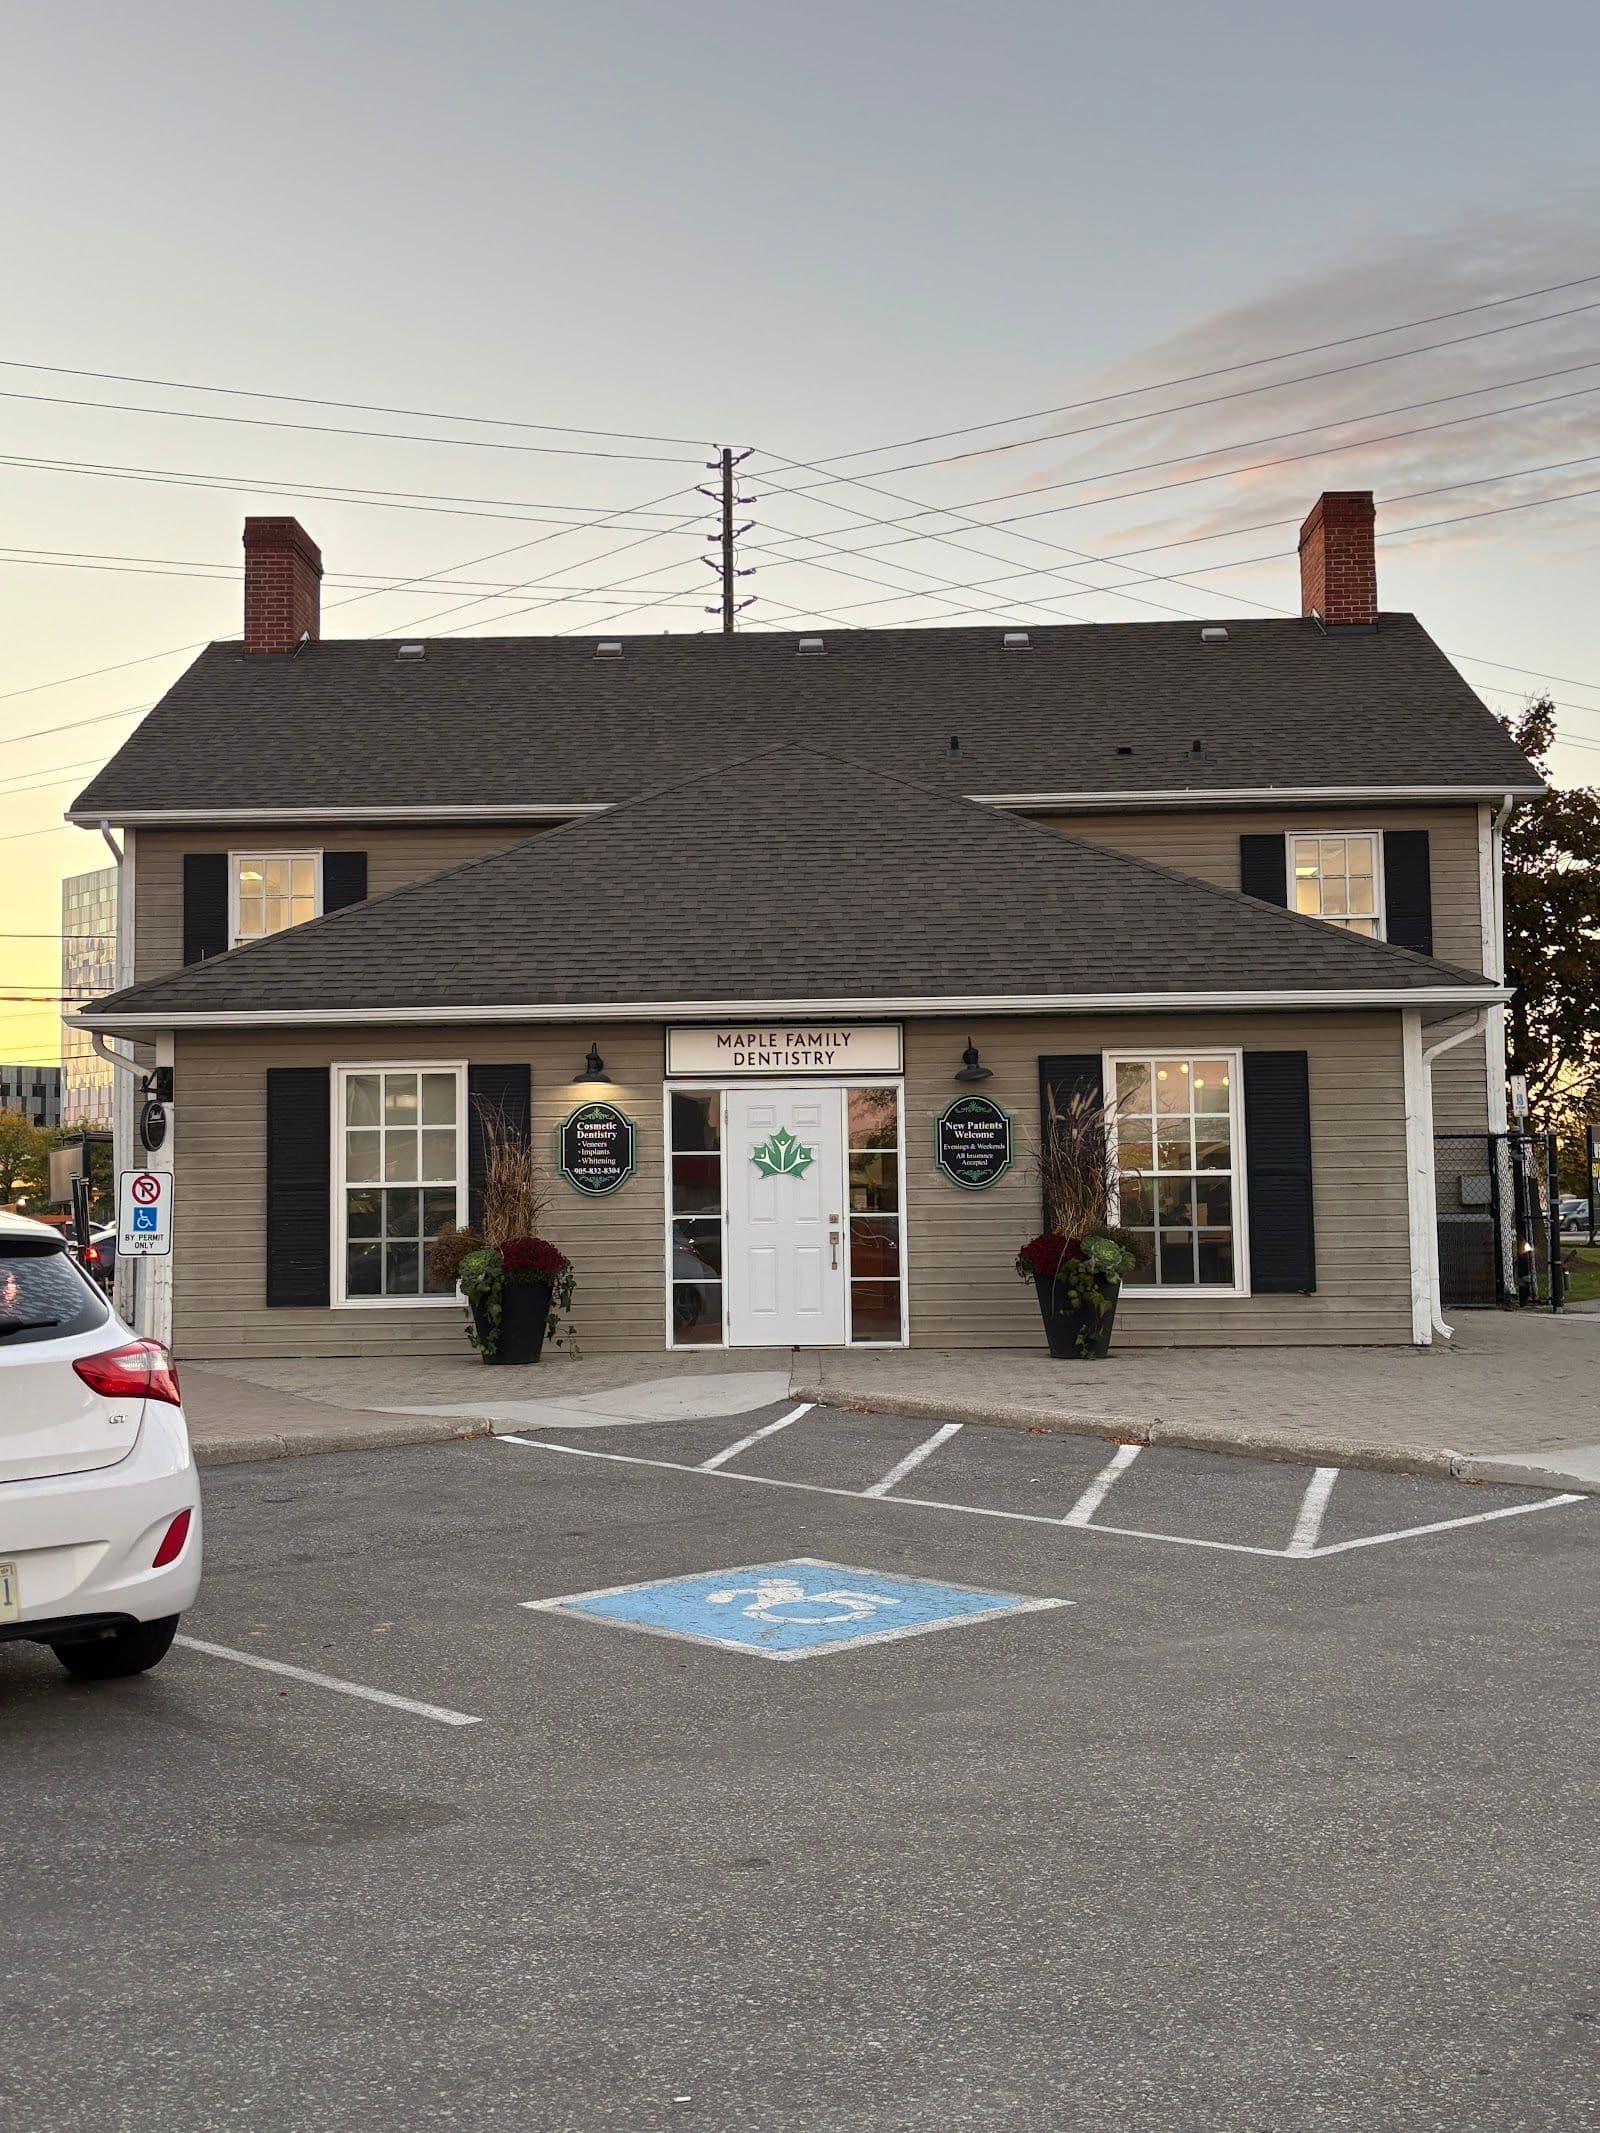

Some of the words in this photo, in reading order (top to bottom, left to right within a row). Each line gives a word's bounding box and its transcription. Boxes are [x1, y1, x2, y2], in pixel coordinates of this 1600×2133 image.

[717, 1033, 777, 1048] MAPLE
[786, 1033, 851, 1047] FAMILY
[734, 1051, 835, 1066] DENTISTRY
[576, 1121, 617, 1131] Cosmetic
[945, 1121, 965, 1131] New
[967, 1121, 1003, 1130] Patients
[576, 1131, 617, 1141] Dentistry
[954, 1130, 995, 1139] Welcome
[581, 1140, 608, 1148] Veneers
[943, 1143, 969, 1151] Evenings
[581, 1148, 610, 1157] Implants
[581, 1156, 617, 1165] Whitening
[124, 1233, 135, 1241] BY
[138, 1233, 164, 1241] PERMIT
[134, 1241, 154, 1249] ONLY
